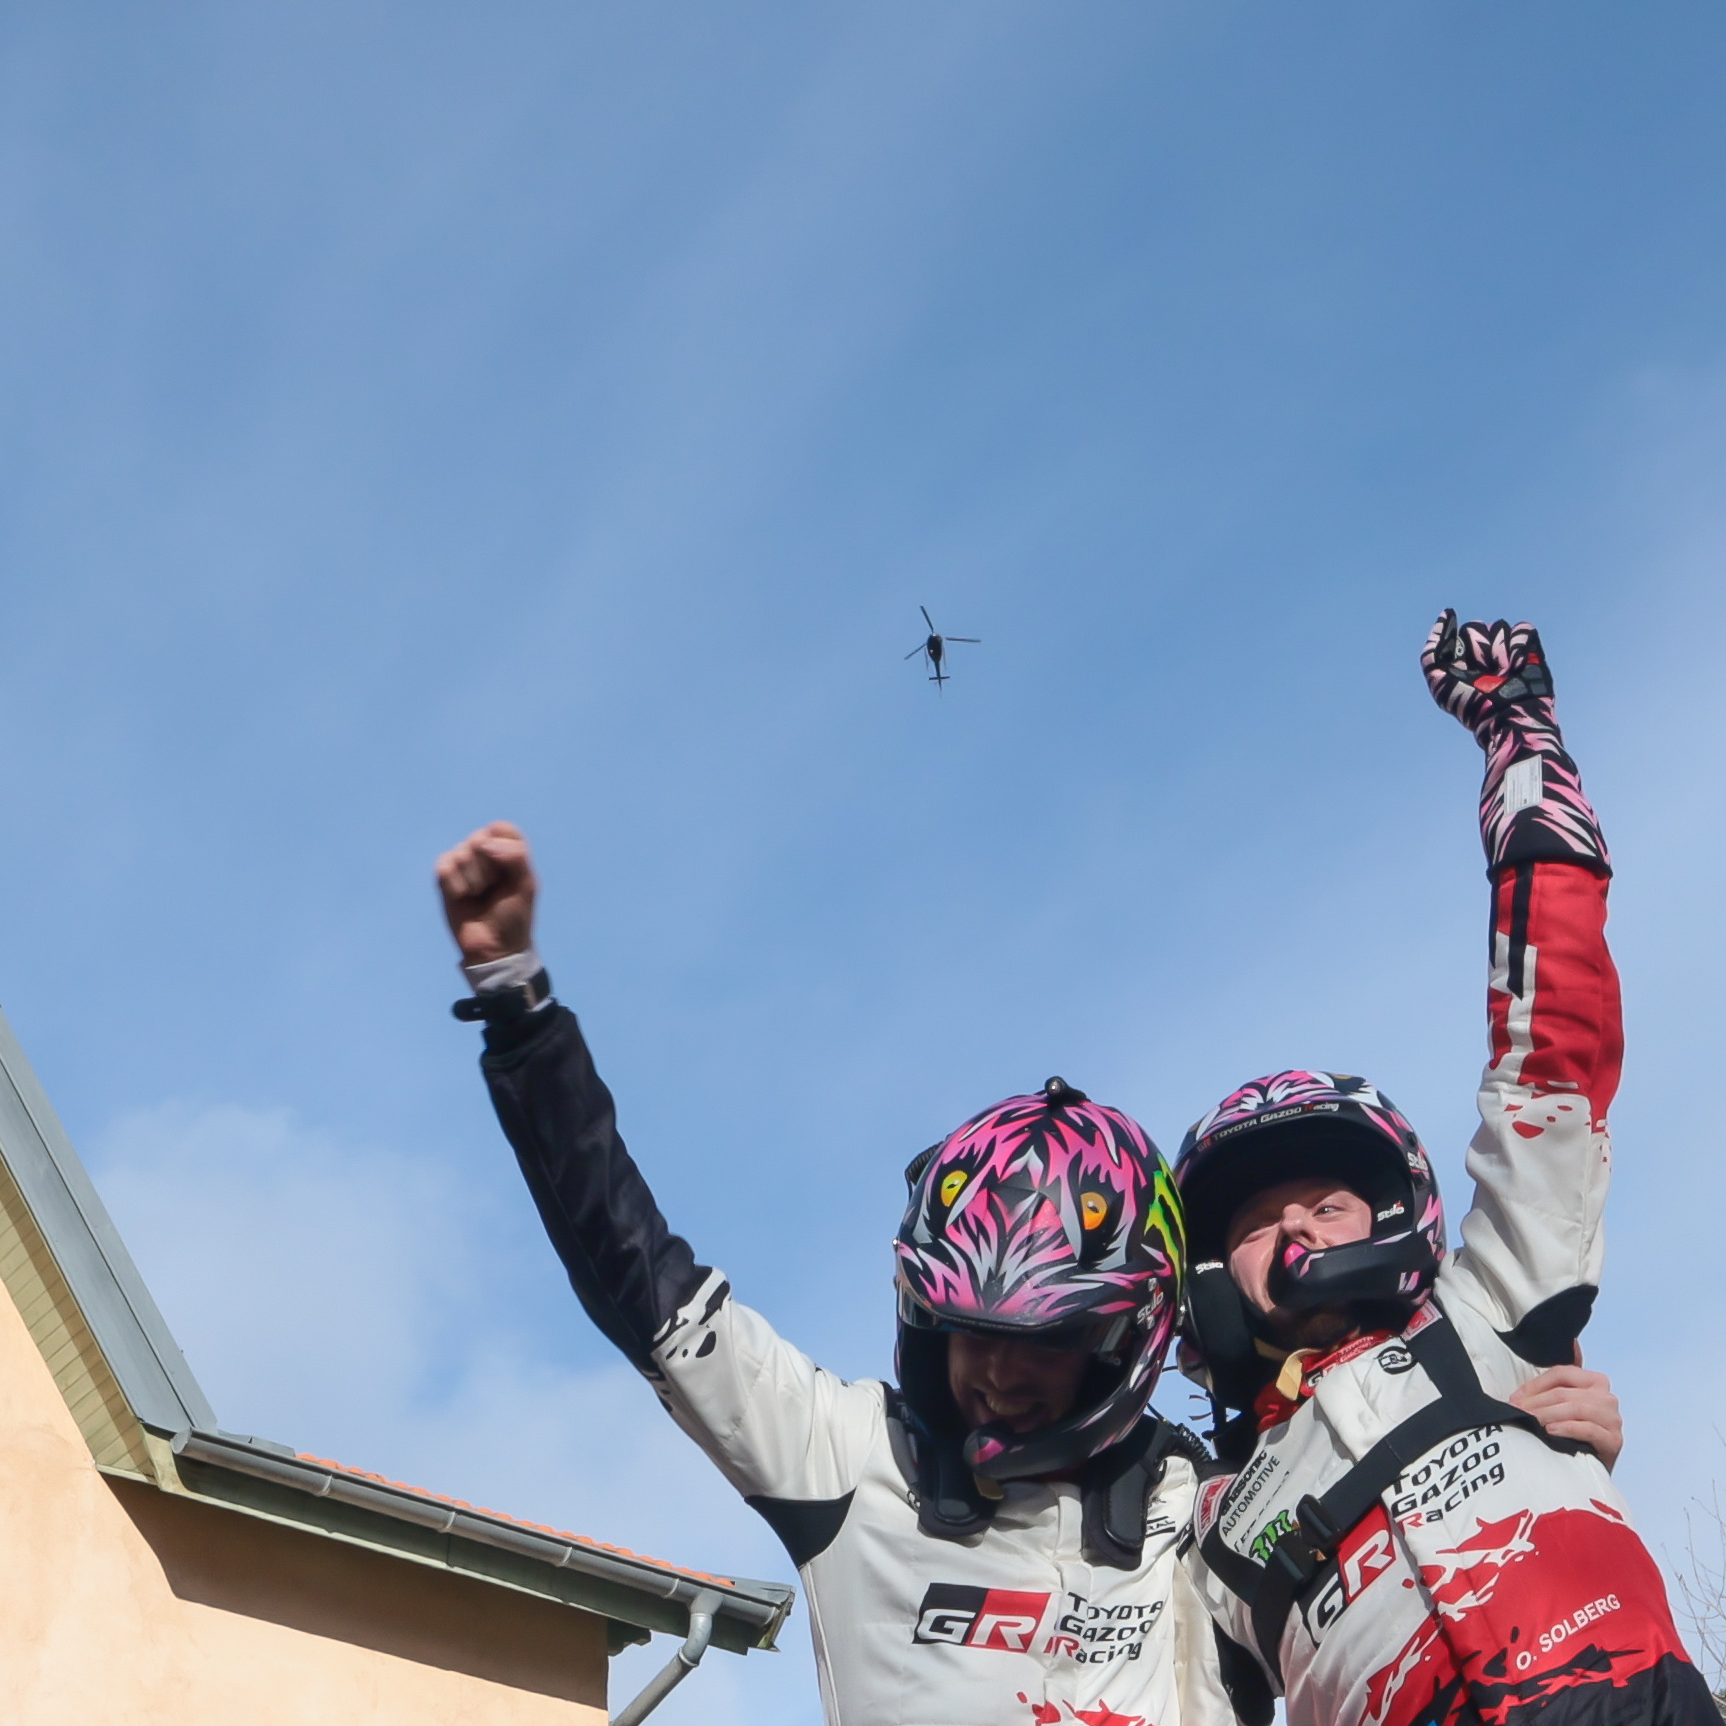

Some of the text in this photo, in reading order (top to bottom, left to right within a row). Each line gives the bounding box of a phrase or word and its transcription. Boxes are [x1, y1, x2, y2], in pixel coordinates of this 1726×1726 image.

[1390, 1423, 1504, 1495] TOYOTA
[1390, 1441, 1501, 1518] GAZOO
[1221, 1455, 1280, 1538] AUTOMOTIVE
[1395, 1462, 1506, 1538] Racing
[917, 1608, 1038, 1652] GR
[1054, 1614, 1155, 1643] GAZOO
[1067, 1591, 1164, 1620] TOYOTA
[1516, 1593, 1621, 1671] O. SOLBERG
